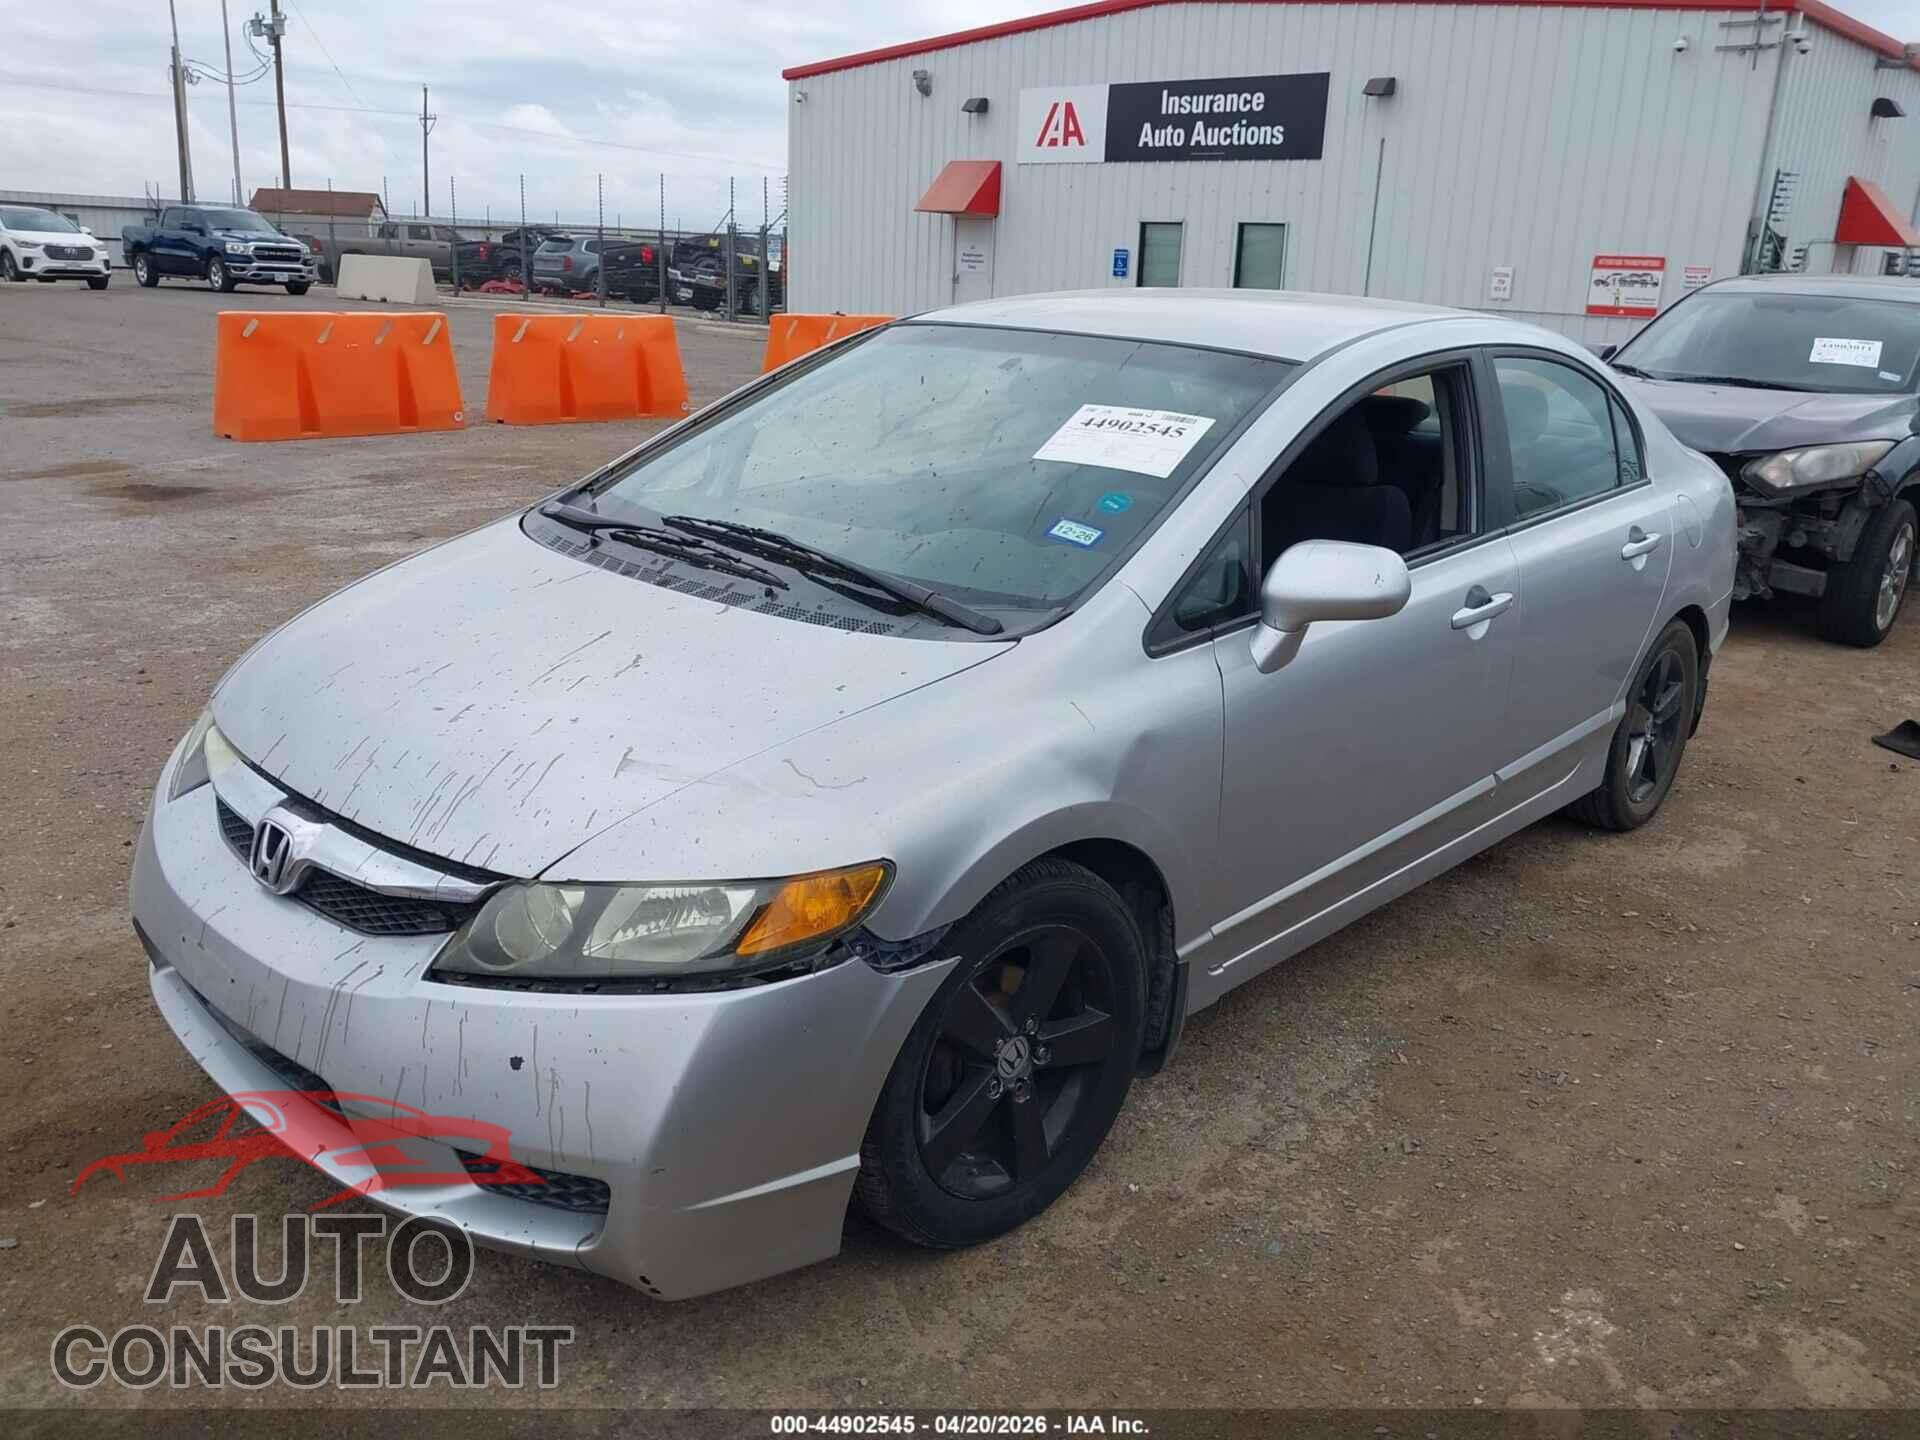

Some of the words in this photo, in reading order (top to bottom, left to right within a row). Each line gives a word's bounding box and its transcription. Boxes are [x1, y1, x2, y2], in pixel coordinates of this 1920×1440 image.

[1161, 89, 1265, 115] Insurance
[1138, 123, 1185, 148] Auto
[1190, 120, 1285, 147] Auctions
[1080, 417, 1187, 439] 44902545
